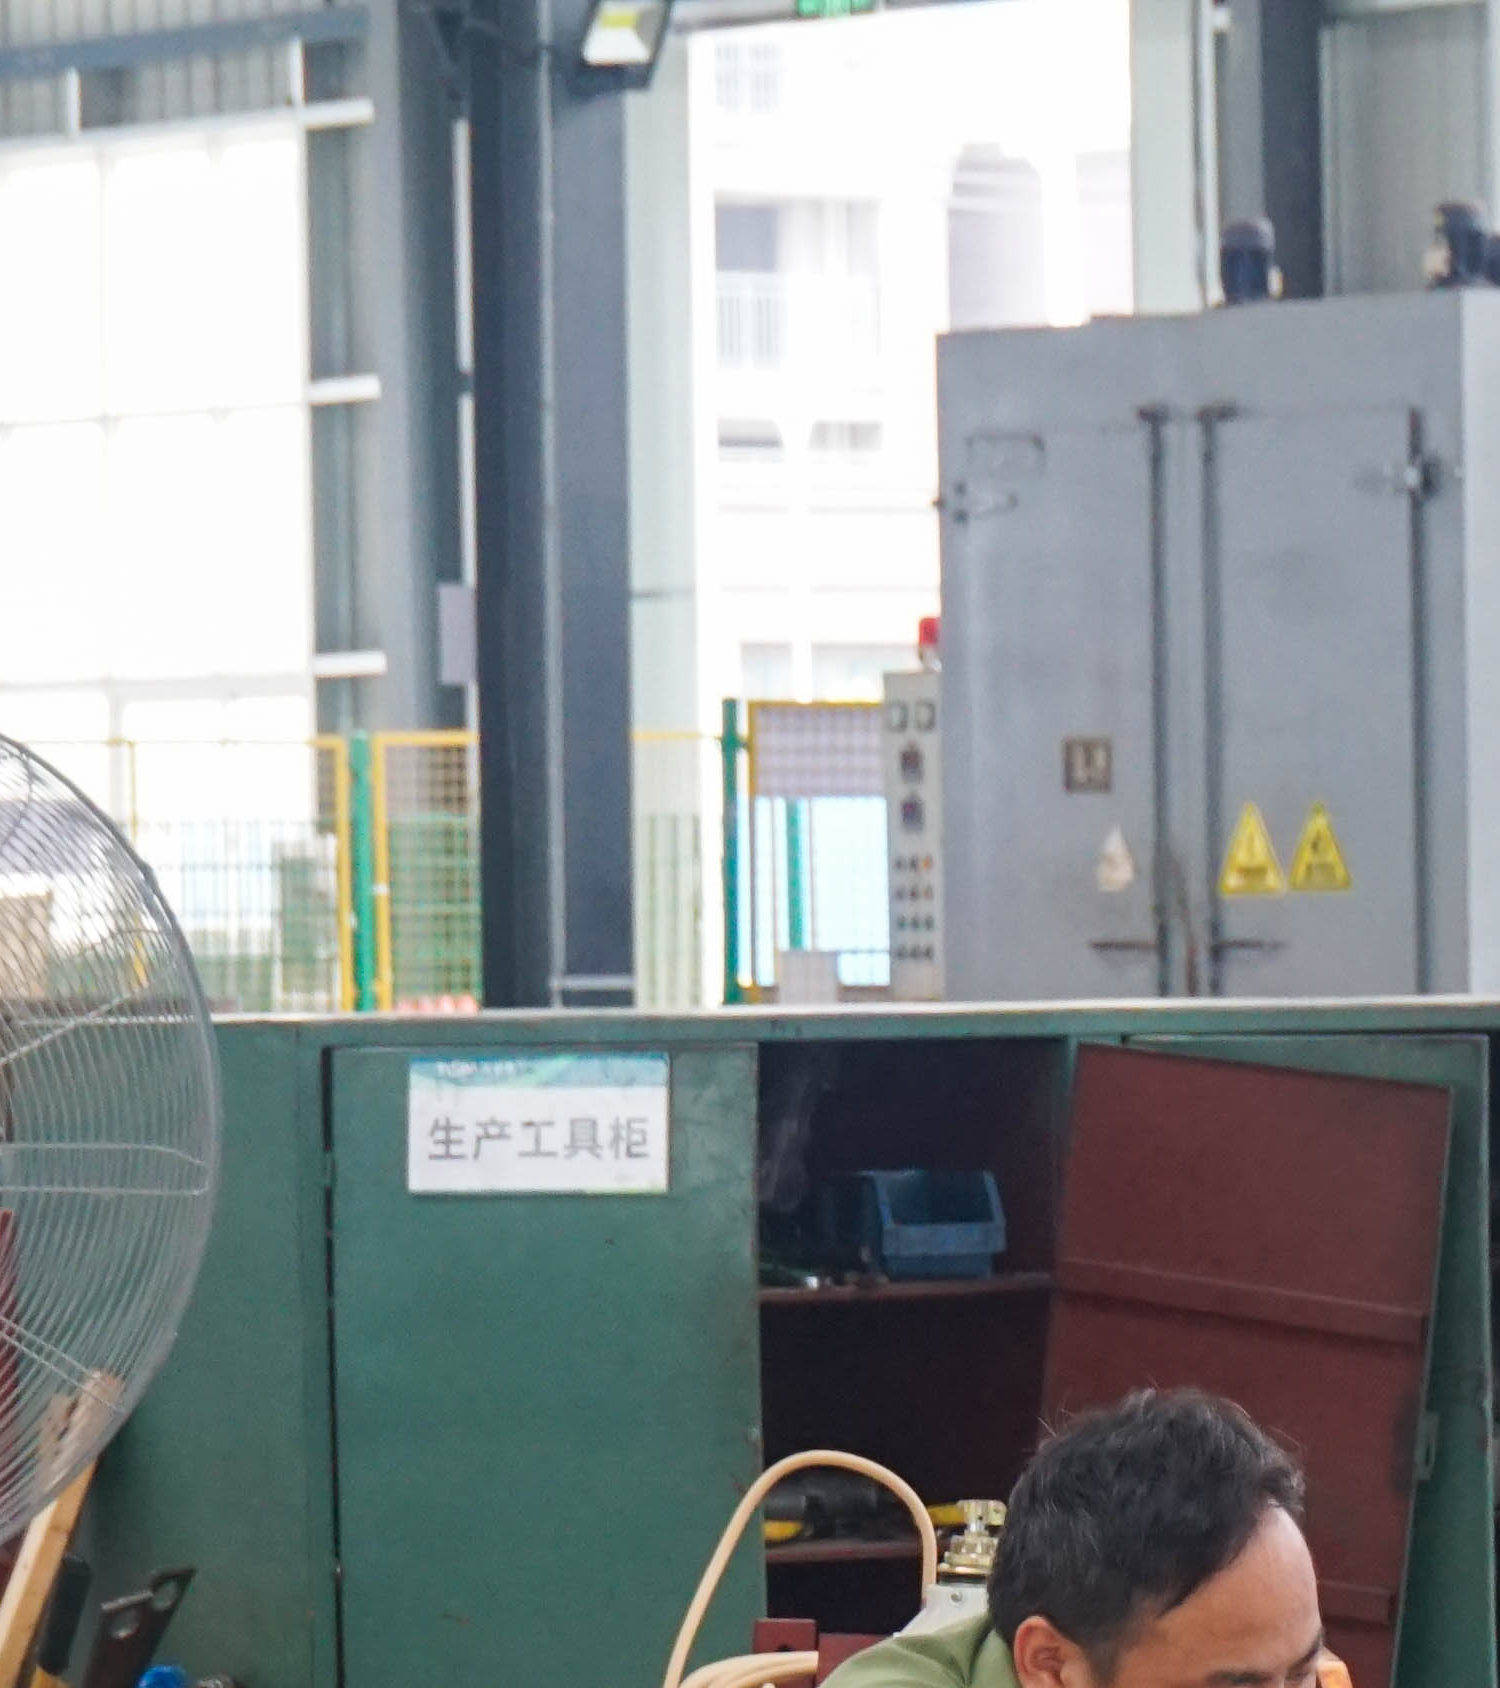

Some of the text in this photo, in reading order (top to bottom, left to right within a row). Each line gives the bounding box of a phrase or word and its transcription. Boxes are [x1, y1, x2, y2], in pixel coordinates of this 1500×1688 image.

[427, 1115, 650, 1160] 生产工具柜
